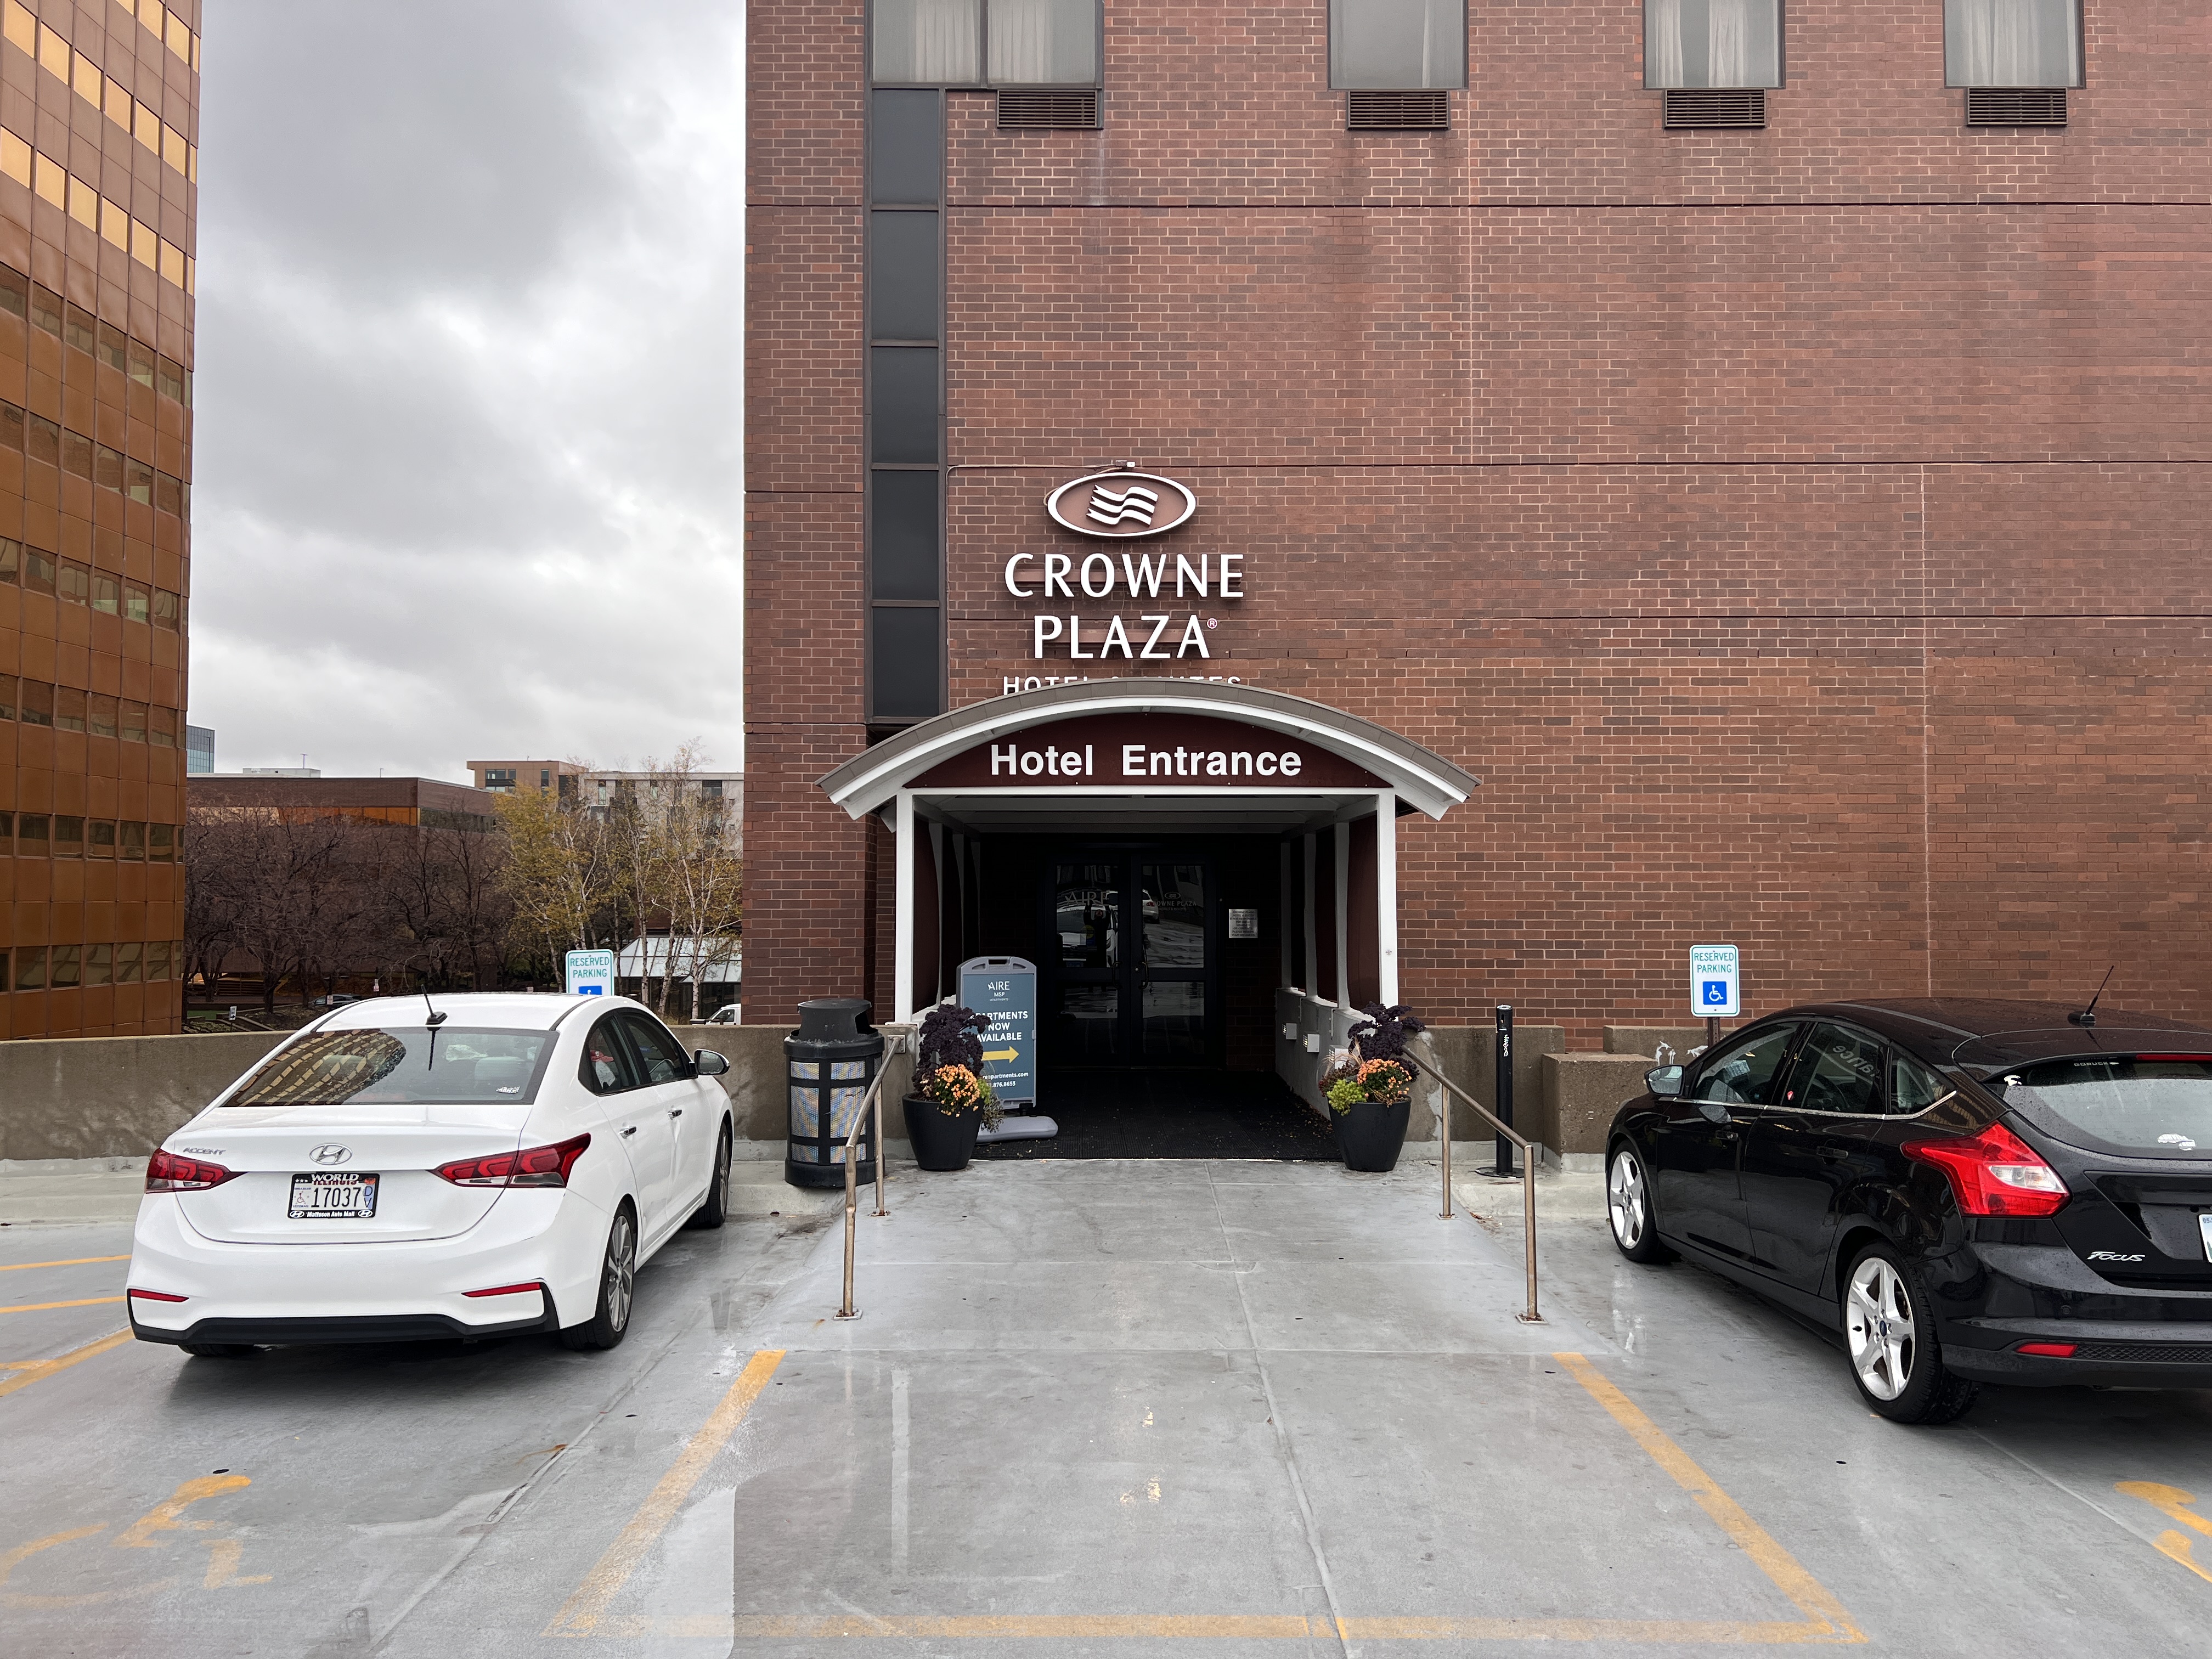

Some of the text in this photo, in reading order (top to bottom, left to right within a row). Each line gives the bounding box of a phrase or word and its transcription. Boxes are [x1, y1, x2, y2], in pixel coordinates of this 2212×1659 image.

[1005, 552, 1244, 598] CROWNE
[1003, 676, 1088, 696] HOT
[991, 744, 1302, 776] Hotel Entrance
[1694, 952, 1734, 961] RESERVED
[571, 957, 610, 967] RESERVED
[1697, 964, 1732, 973] PARKING
[573, 969, 607, 978] PARKING
[988, 981, 1010, 991] AIRE
[988, 1022, 1010, 1031] NOW
[183, 1147, 226, 1155] ACCENT
[311, 1173, 359, 1182] WORLD
[311, 1187, 361, 1207] 17037
